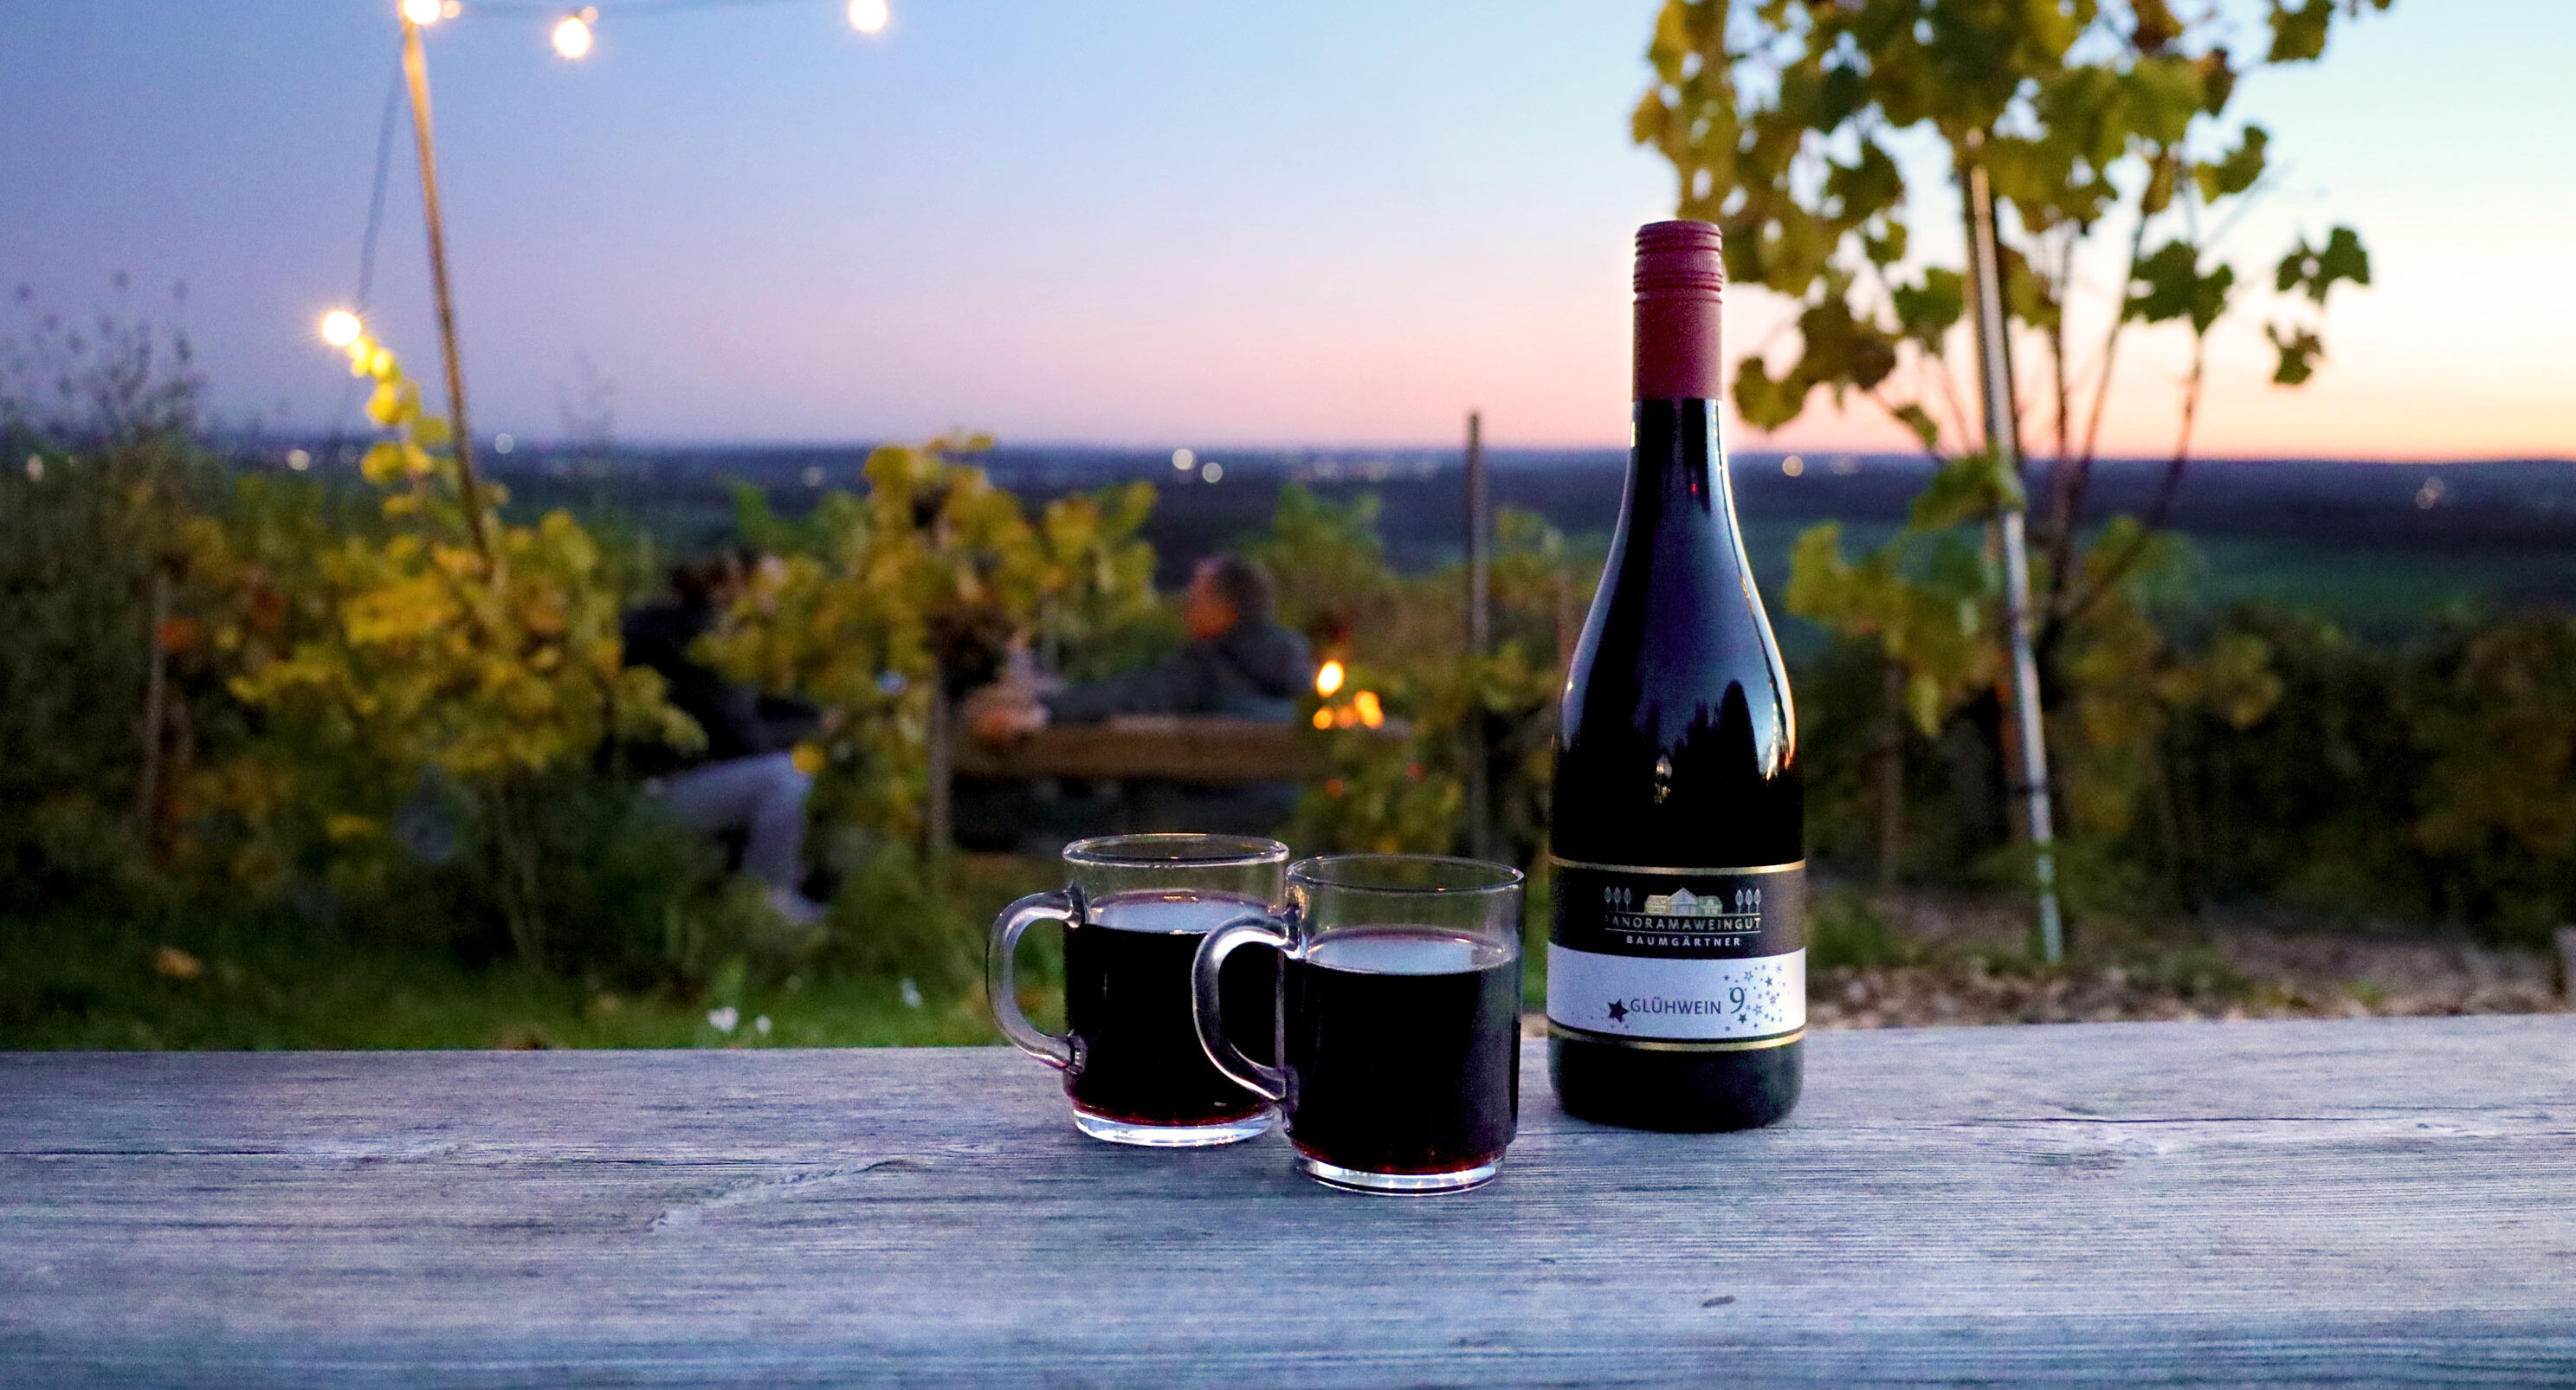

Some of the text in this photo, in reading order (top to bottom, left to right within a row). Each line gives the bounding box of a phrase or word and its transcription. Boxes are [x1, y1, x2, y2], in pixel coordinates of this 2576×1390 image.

[1626, 935, 1740, 947] BAUMGÄRTNER
[1630, 986, 1746, 1015] GLÜHWEIN 9
